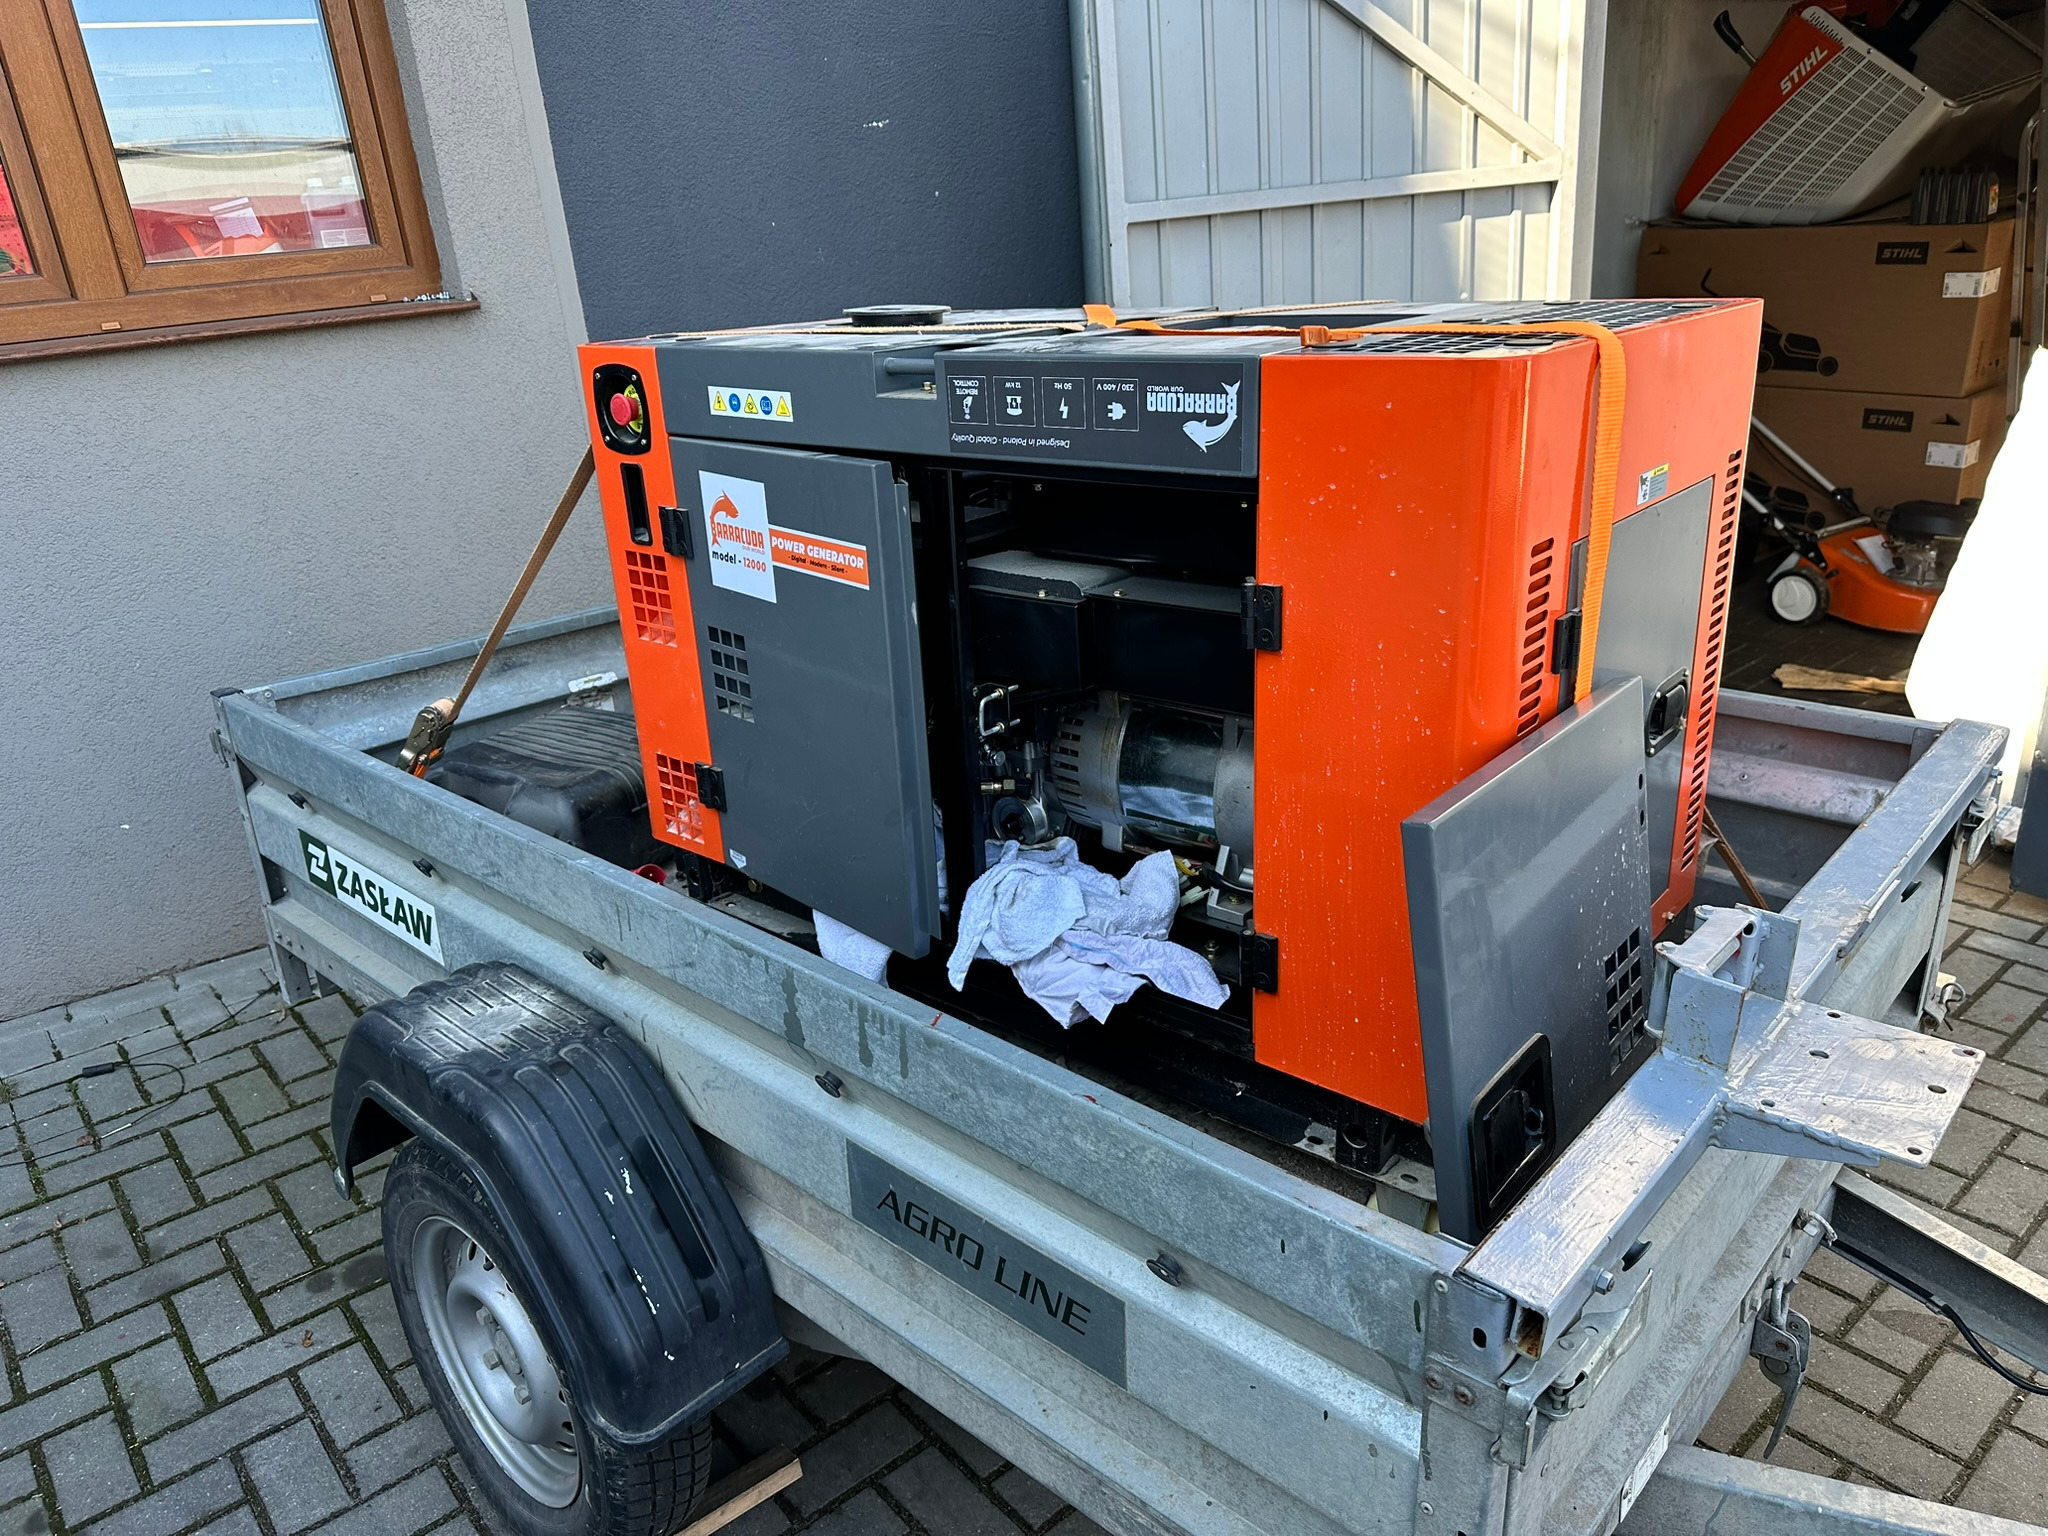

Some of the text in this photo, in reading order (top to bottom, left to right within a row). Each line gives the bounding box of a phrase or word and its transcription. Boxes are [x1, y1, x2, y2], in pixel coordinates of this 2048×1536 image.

[1780, 46, 1828, 96] STIHL
[1881, 247, 1923, 259] STIHL
[1096, 383, 1103, 391] V
[1103, 383, 1117, 391] 400
[1121, 383, 1135, 391] 230
[1146, 391, 1237, 414] BARRACUDA
[1868, 414, 1907, 426] STIHL
[951, 433, 975, 443] Quality
[976, 435, 998, 444] Global
[1002, 437, 1027, 446] Poland
[1028, 438, 1036, 447] in
[1036, 438, 1070, 448] Designed
[711, 522, 765, 550] BARRACUDA
[771, 536, 864, 569] POWER GENERATOR
[712, 550, 737, 565] model
[743, 557, 767, 573] 12000
[791, 555, 807, 564] Digital
[335, 860, 433, 946] ZASŁAW
[876, 1189, 1092, 1336] AGRO LINE
